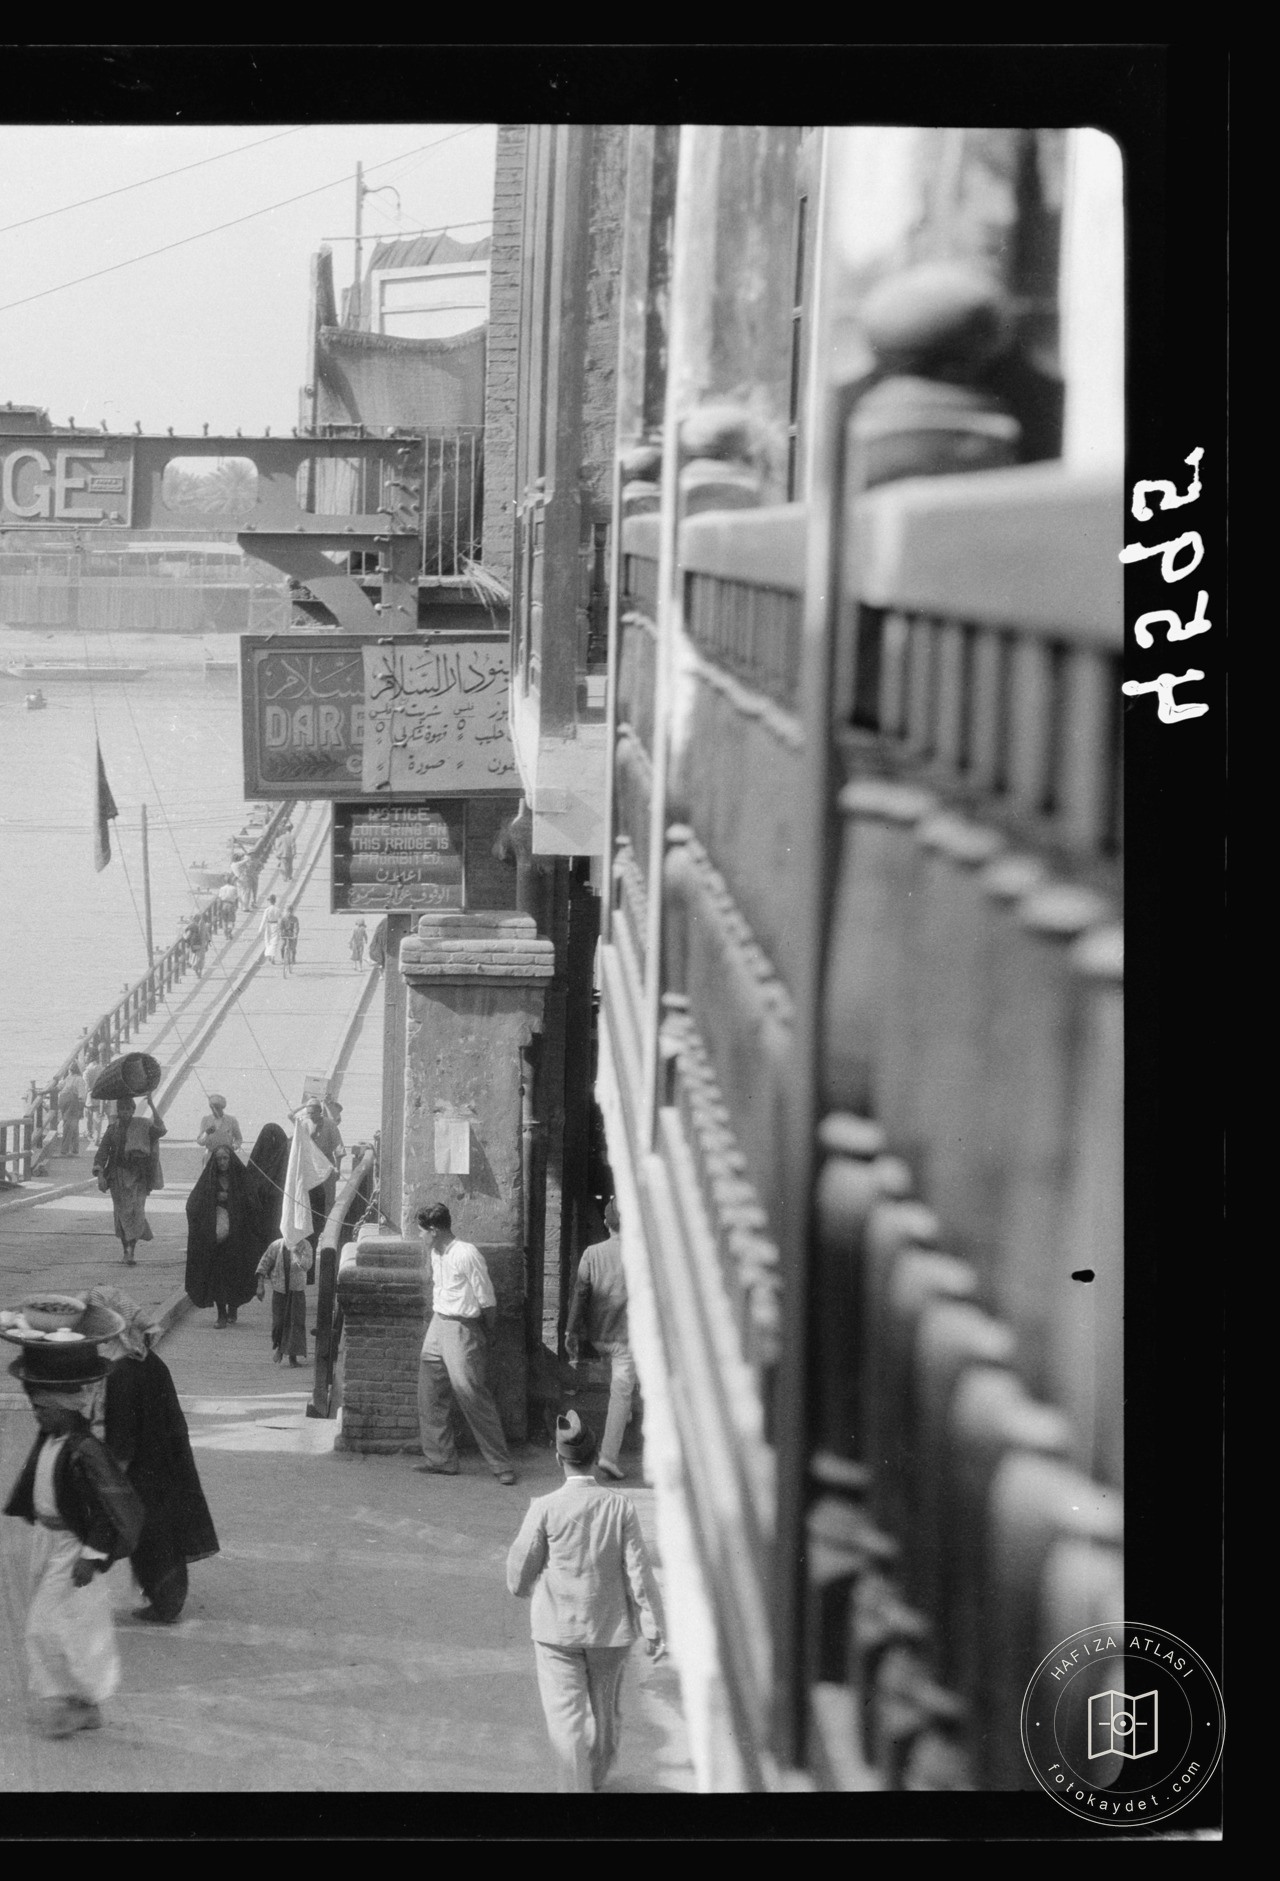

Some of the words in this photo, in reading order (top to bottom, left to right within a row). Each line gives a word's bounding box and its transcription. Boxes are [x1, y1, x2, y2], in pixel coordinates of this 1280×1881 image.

[265, 705, 343, 748] DAR
[369, 807, 430, 821] NOTICE
[352, 823, 422, 836] LOITERING
[428, 823, 448, 836] ON
[350, 838, 381, 850] THIS
[437, 838, 450, 850] IS
